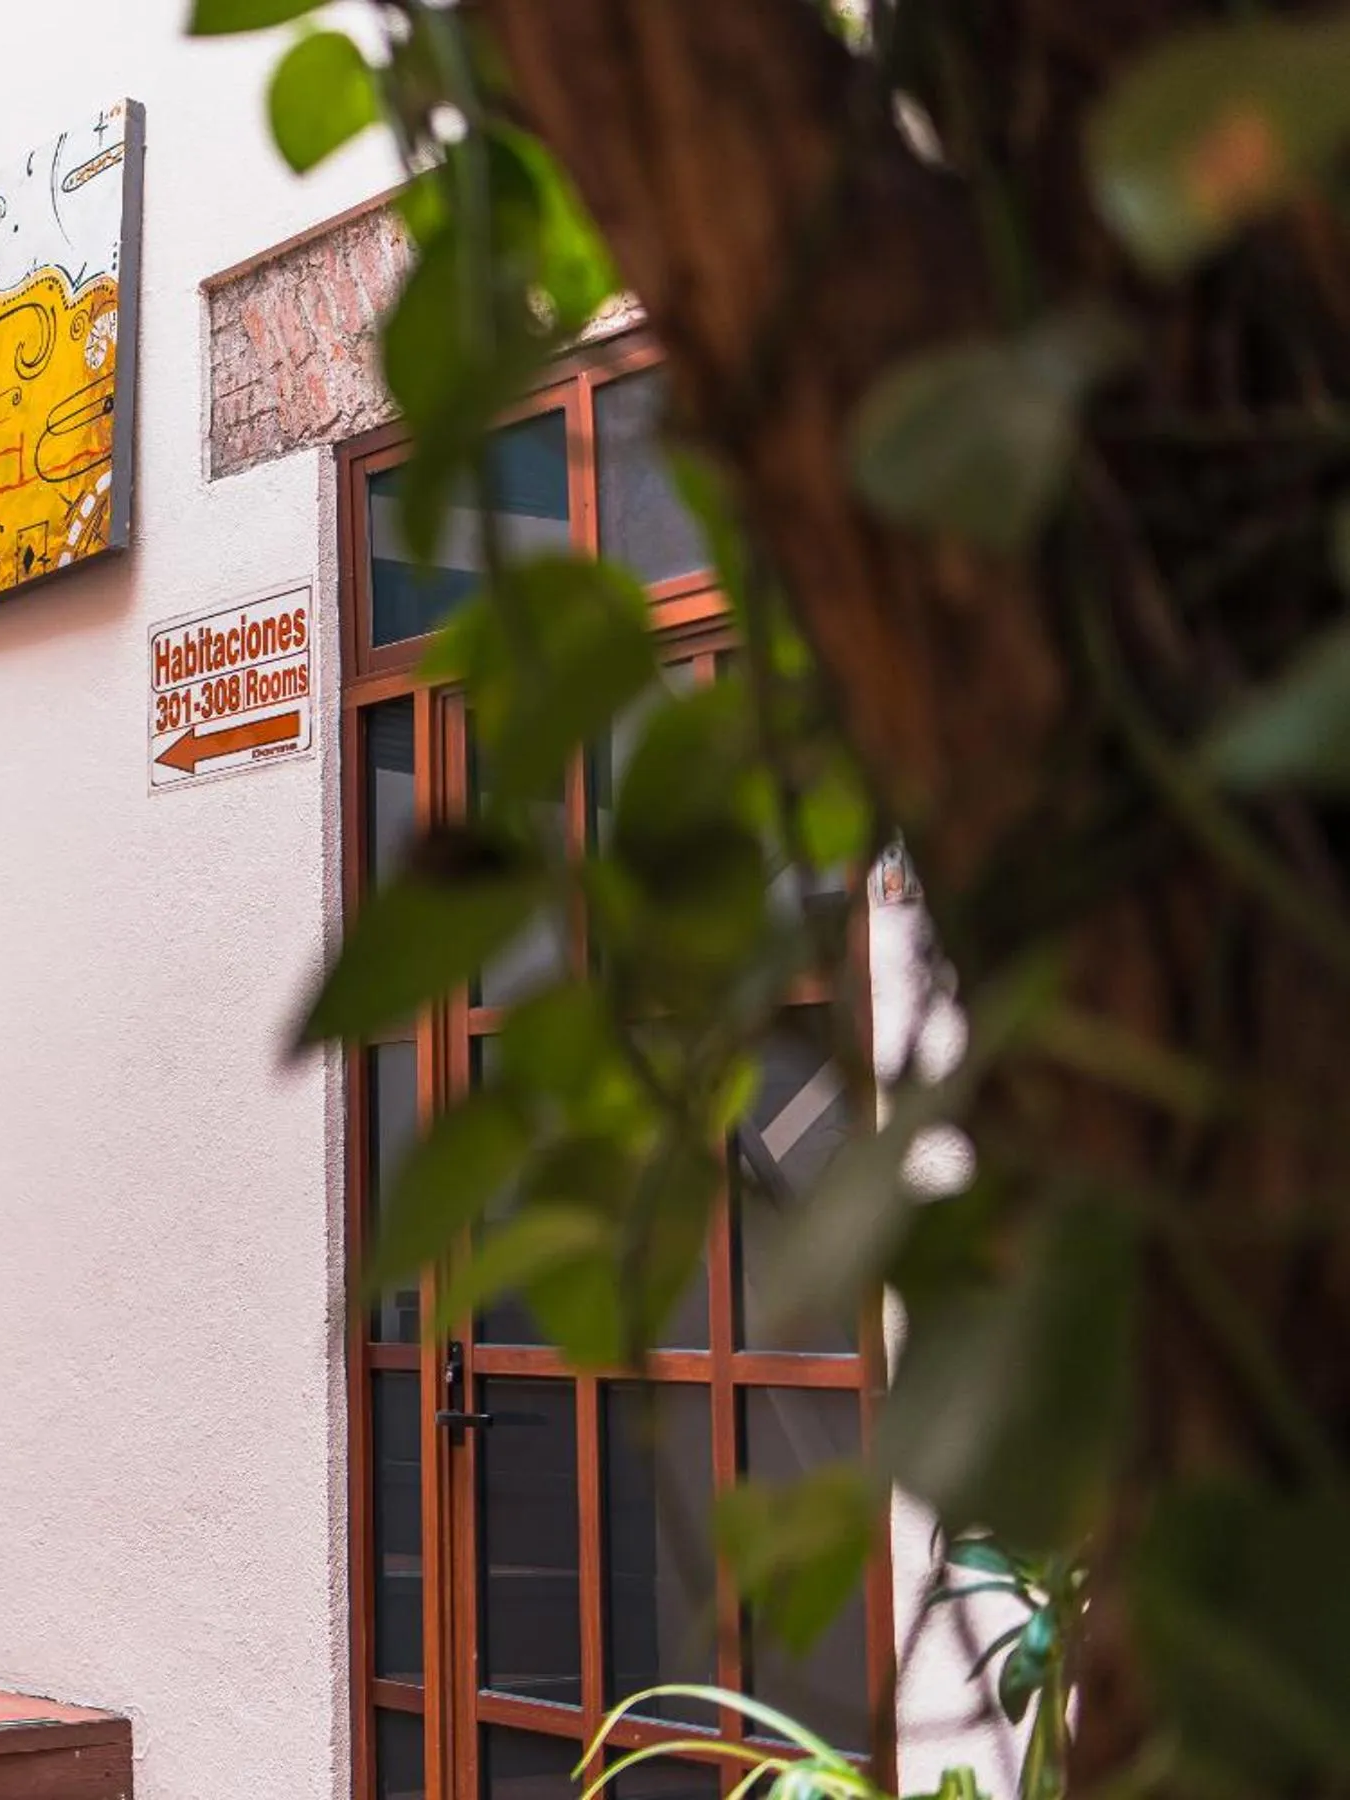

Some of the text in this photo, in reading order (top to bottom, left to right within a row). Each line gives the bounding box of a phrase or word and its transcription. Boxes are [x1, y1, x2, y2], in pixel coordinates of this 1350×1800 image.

[155, 608, 306, 686] Habitaciones
[156, 663, 307, 731] 301-308 Rooms
